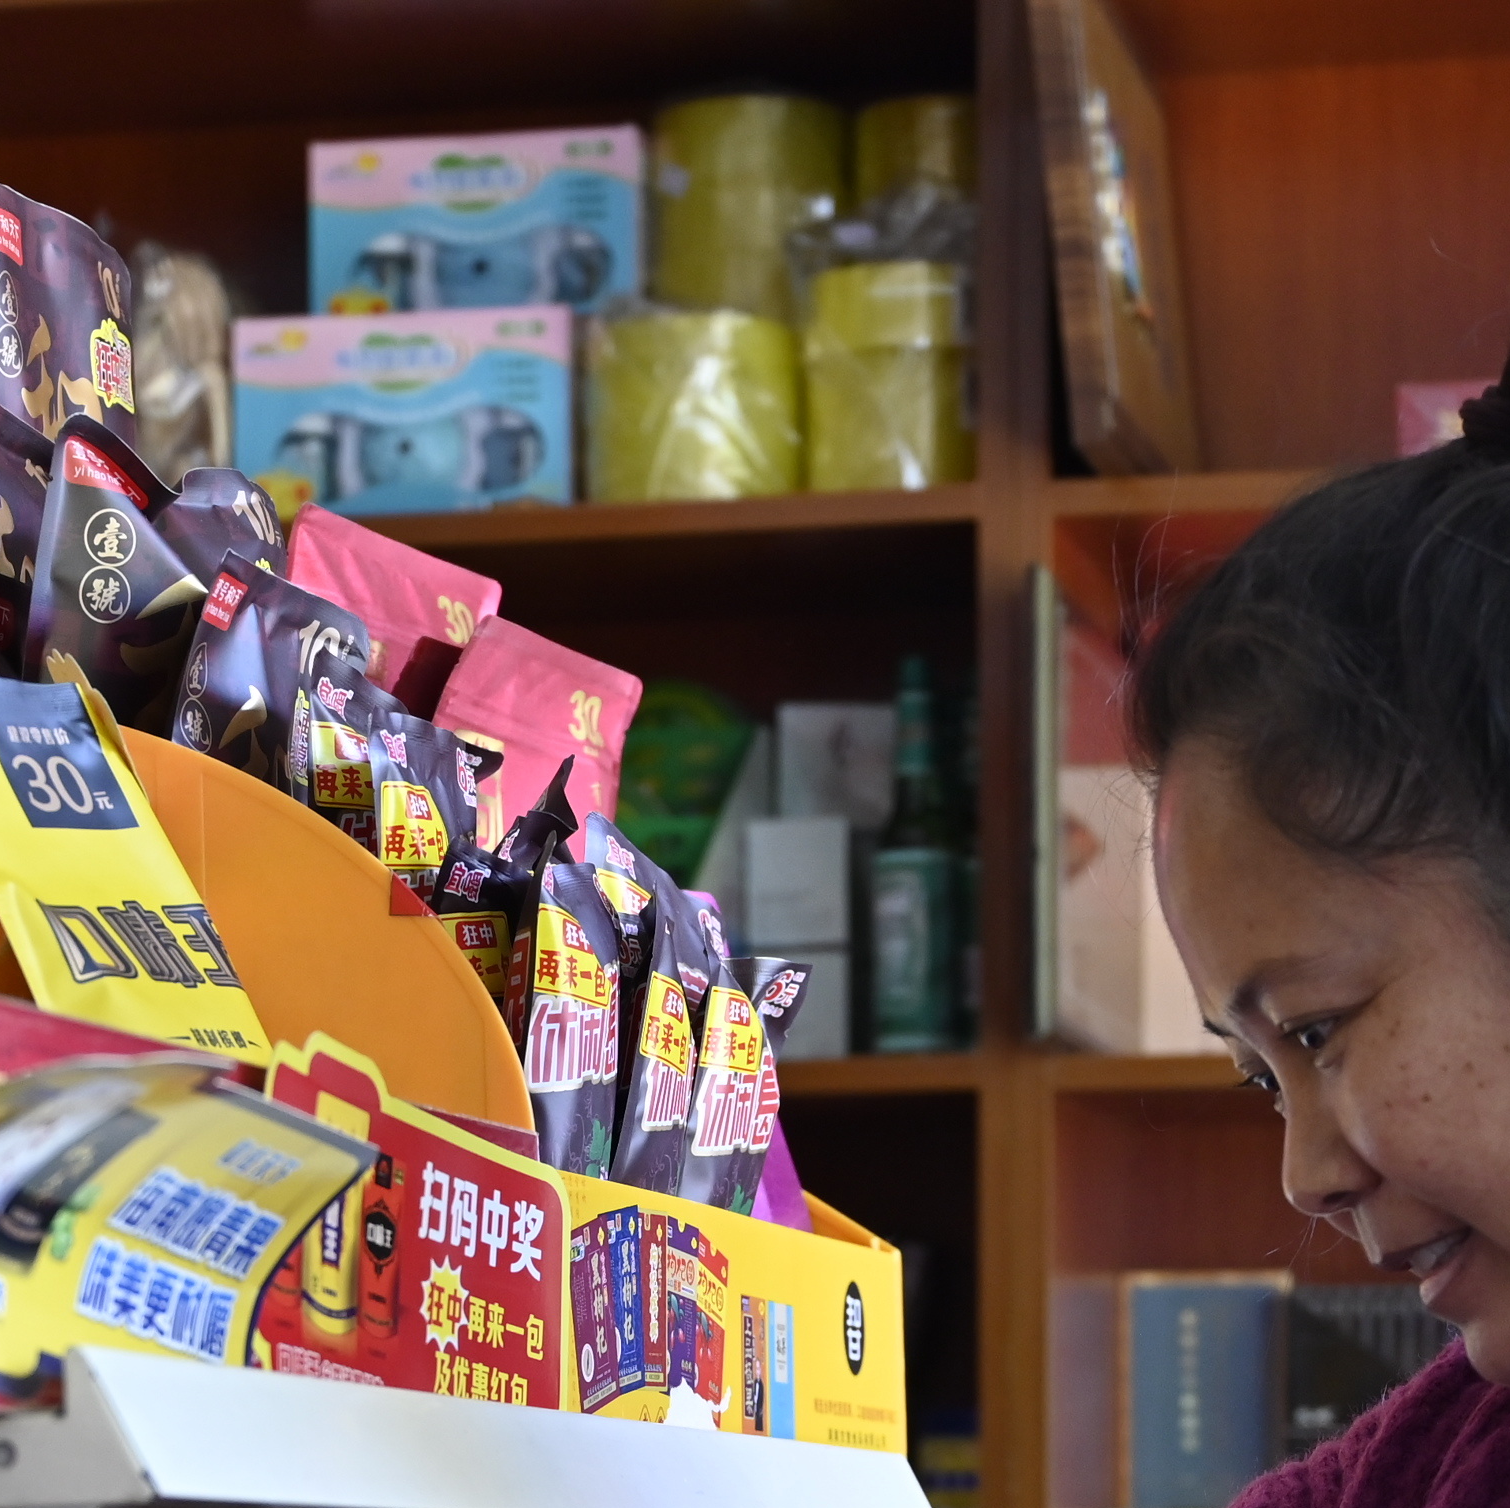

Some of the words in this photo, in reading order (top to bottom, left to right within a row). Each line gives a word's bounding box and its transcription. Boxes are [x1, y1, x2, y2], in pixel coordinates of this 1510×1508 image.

[85, 516, 128, 616] 壹號
[11, 753, 115, 815] 30元
[315, 765, 372, 801] 再来一
[462, 923, 494, 947] 狂中
[538, 950, 607, 998] 再来一包
[728, 1002, 751, 1028] 狂中
[705, 1026, 758, 1066] 再来一包
[418, 1160, 545, 1282] 扫码中奖
[426, 1281, 464, 1335] 狂中
[467, 1295, 545, 1361] 再来一包
[433, 1350, 530, 1407] 及优惠红包
